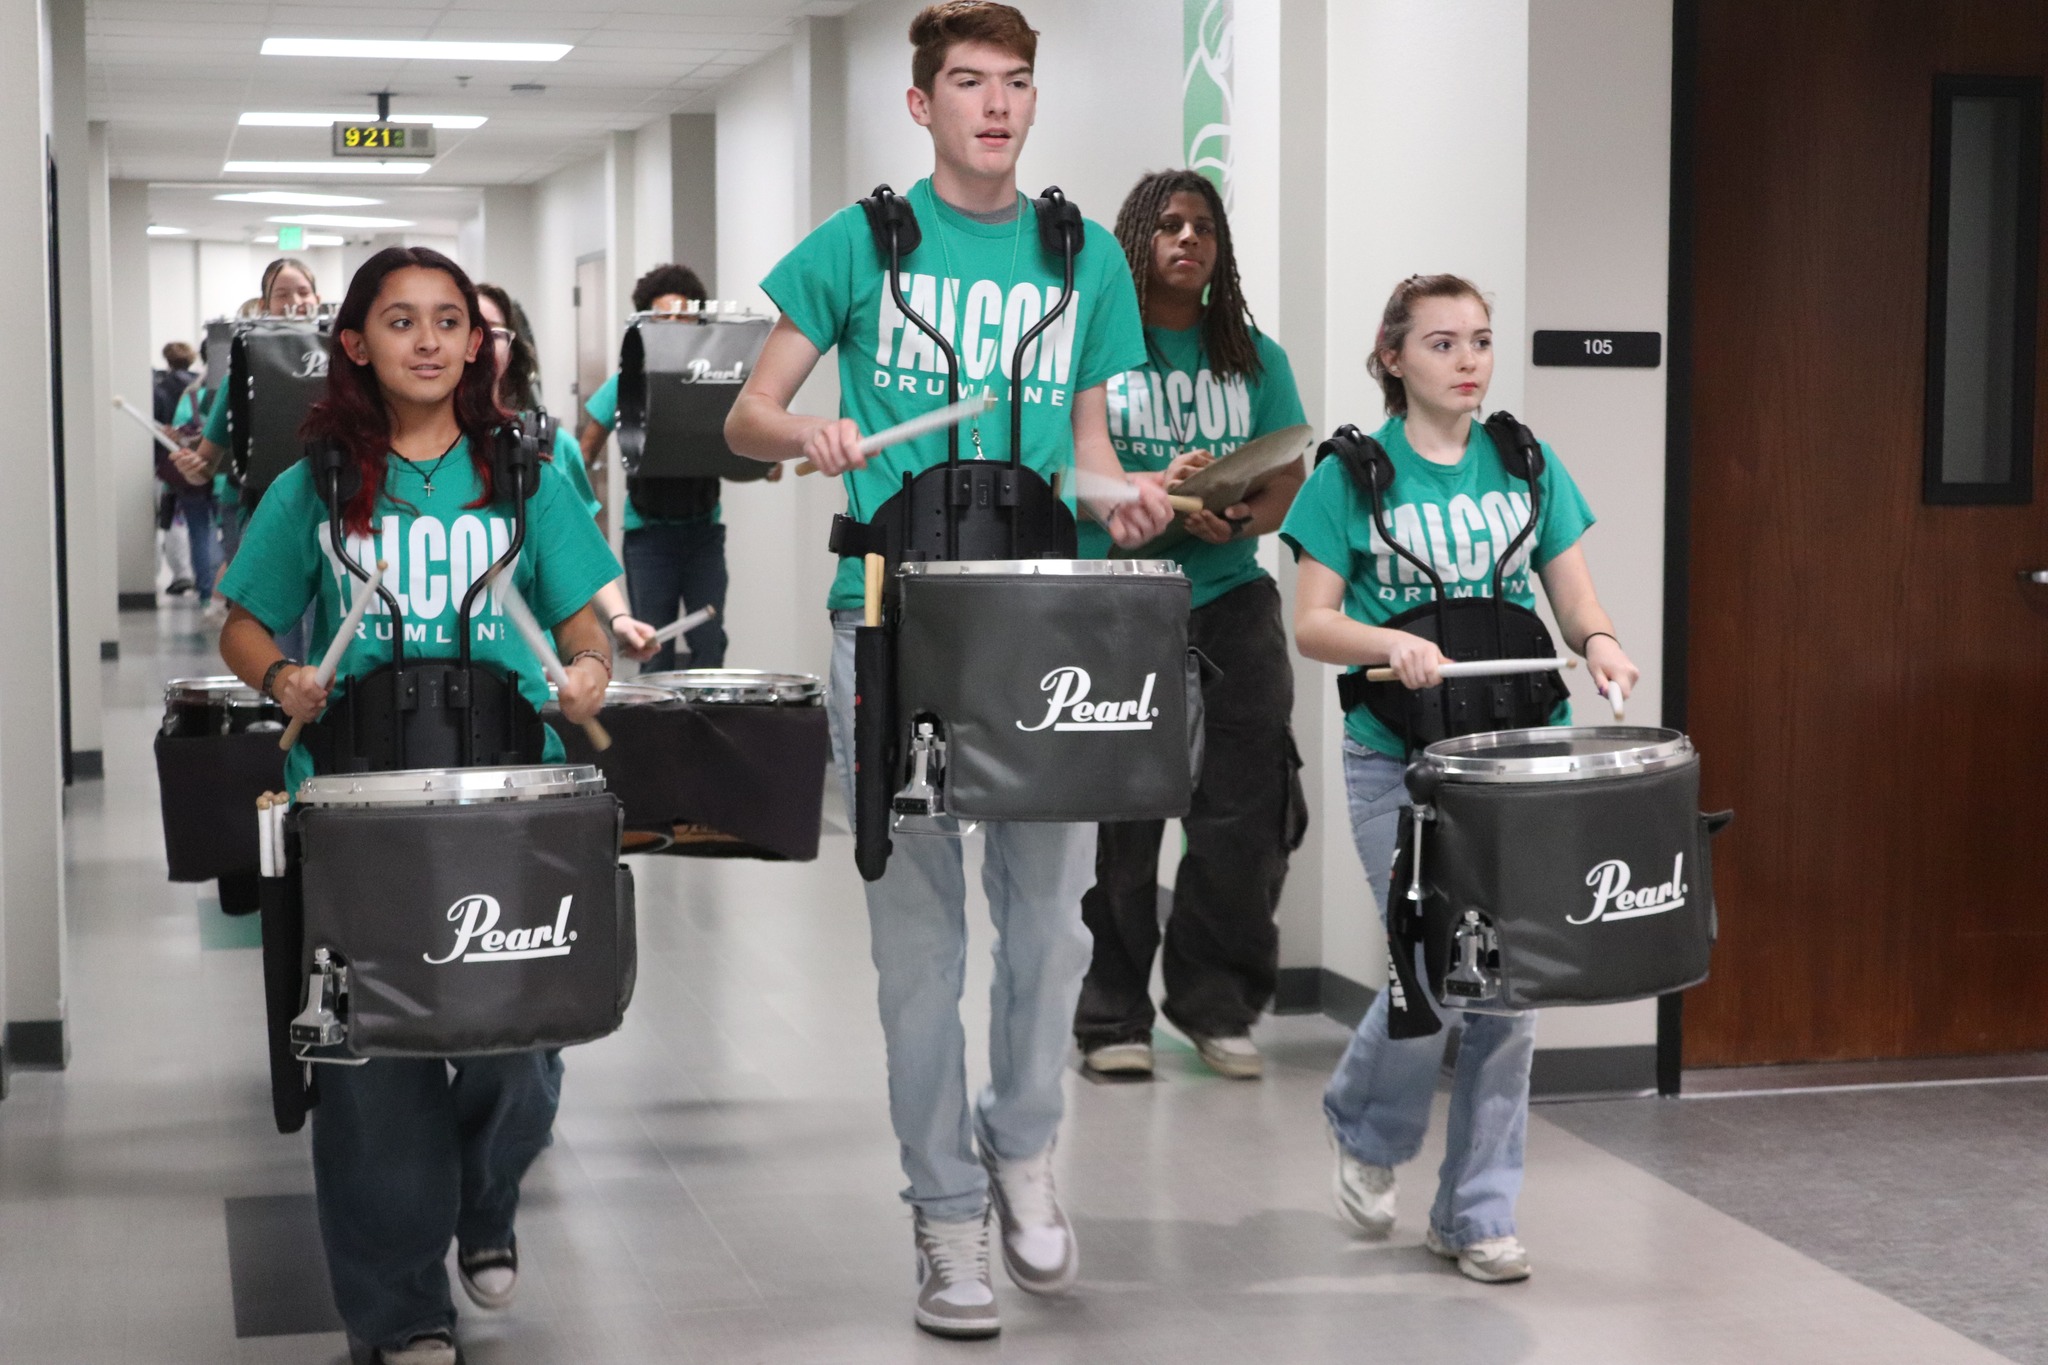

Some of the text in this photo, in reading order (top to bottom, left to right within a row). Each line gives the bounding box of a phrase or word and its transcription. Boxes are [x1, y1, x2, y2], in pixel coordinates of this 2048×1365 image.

[875, 270, 1080, 385] FALCON
[1583, 339, 1613, 354] 105
[680, 358, 744, 384] Pearl
[1106, 369, 1250, 443] FALCON
[1369, 491, 1537, 584] FALCON
[1016, 666, 1158, 731] Pearl
[1565, 852, 1684, 925] Pearl
[423, 894, 573, 964] Pearl
